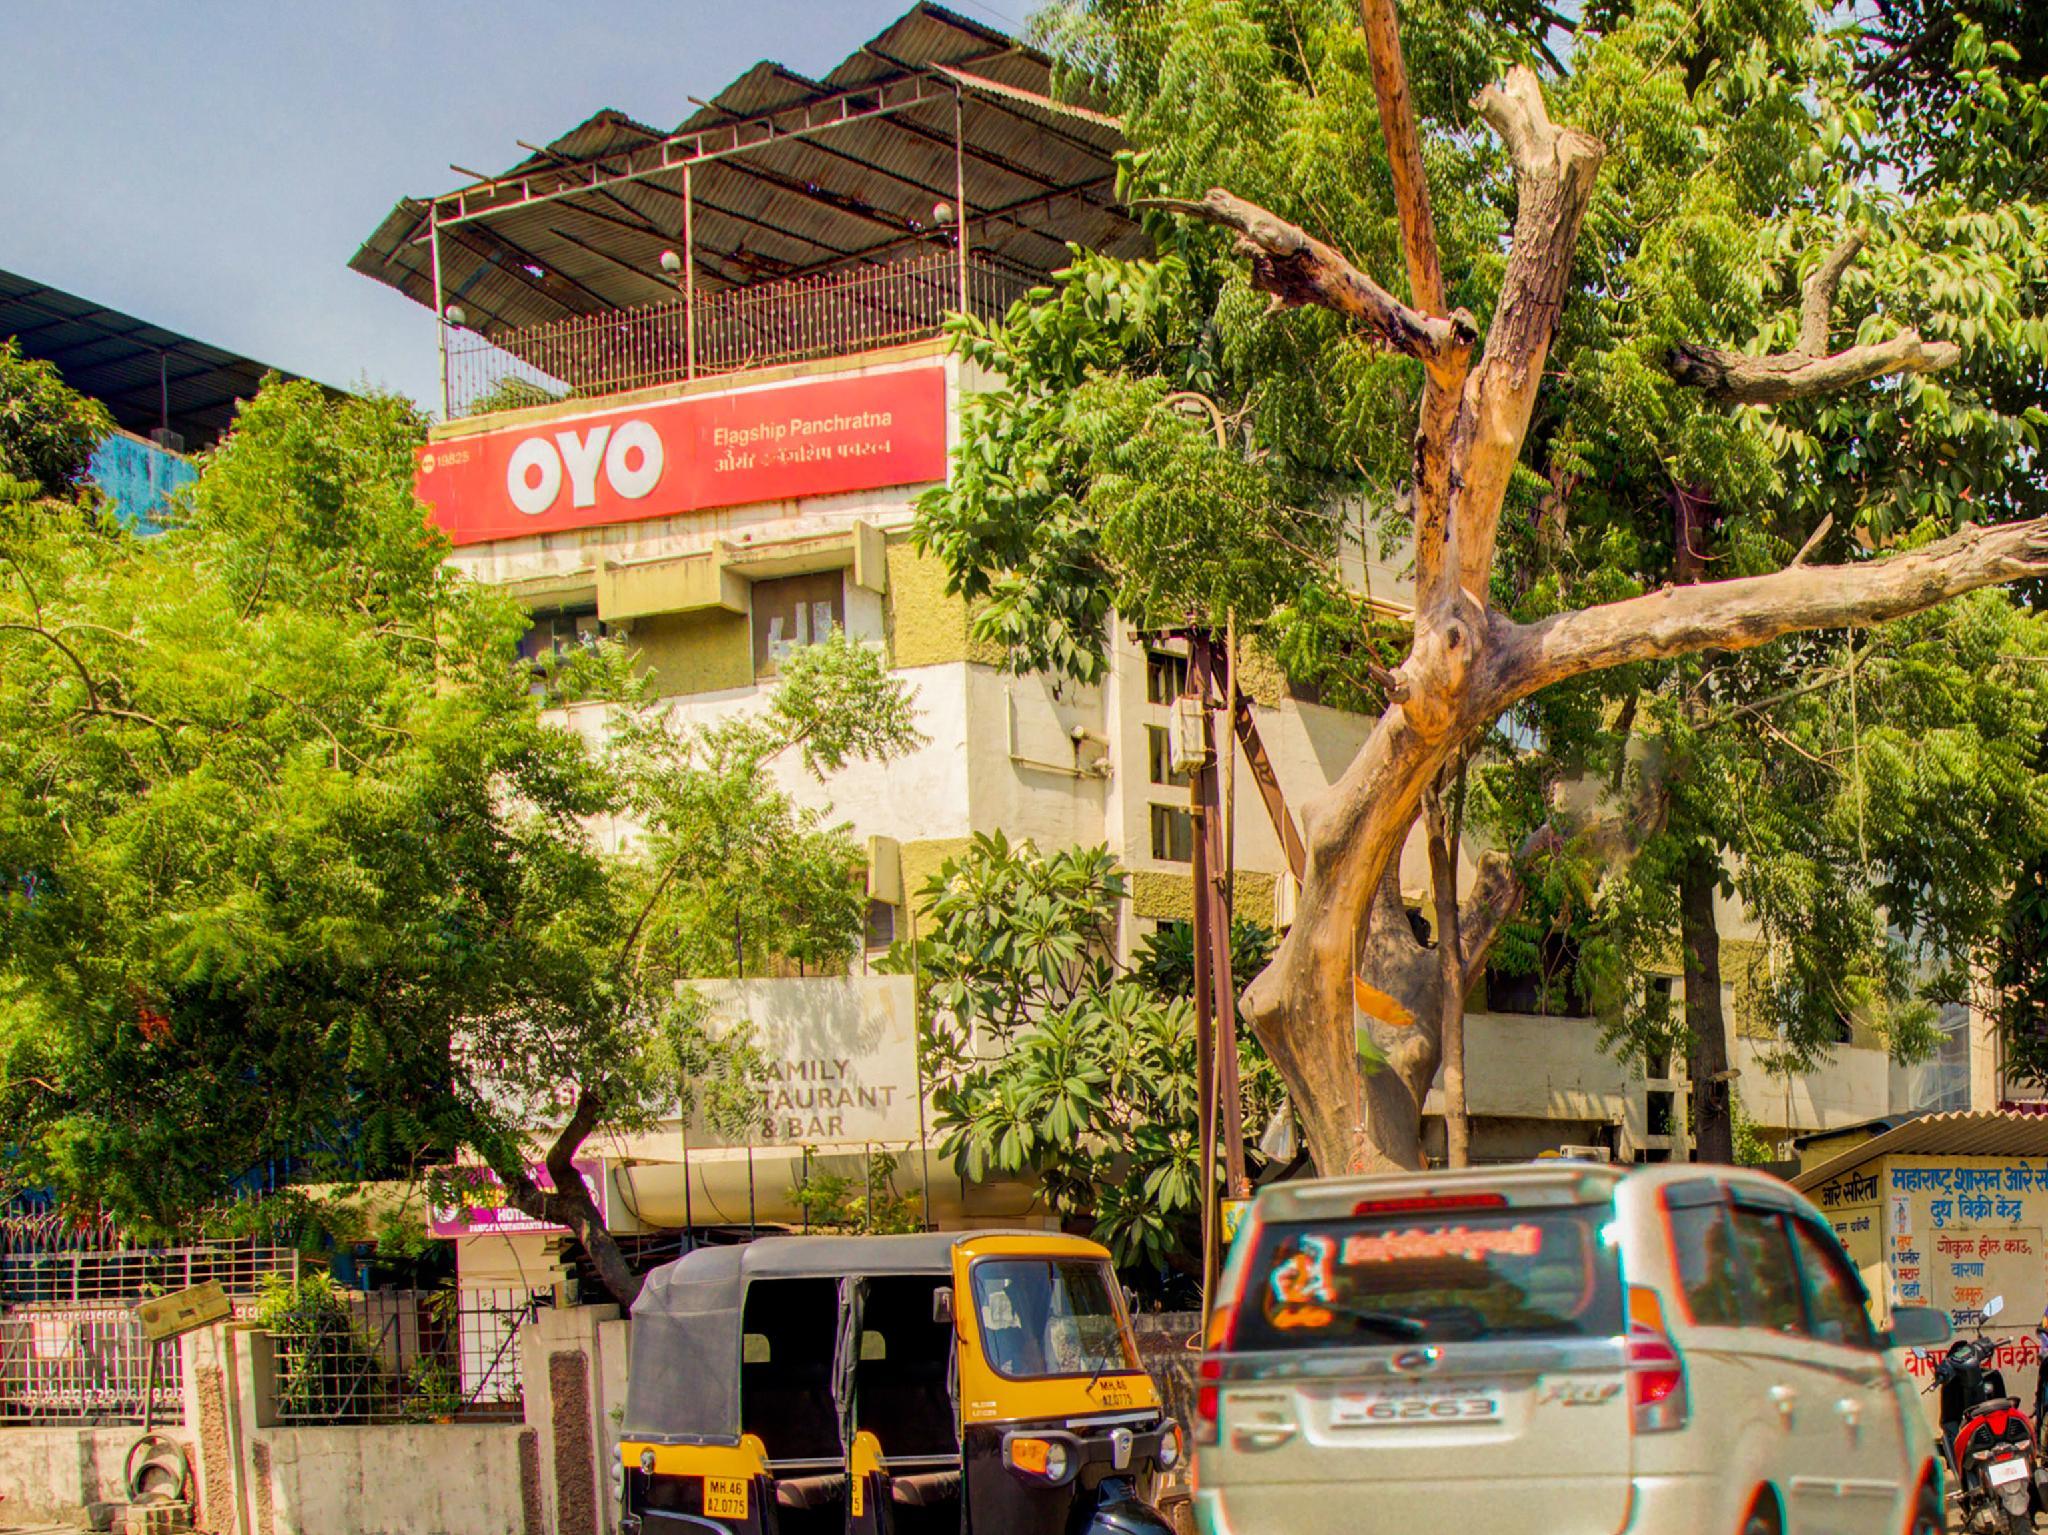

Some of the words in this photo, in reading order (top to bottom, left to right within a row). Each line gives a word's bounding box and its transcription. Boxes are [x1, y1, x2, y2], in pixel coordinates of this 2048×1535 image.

[714, 423, 786, 447] Flagship
[790, 411, 892, 436] Panchratna
[507, 419, 664, 515] OYO
[764, 1059, 850, 1082] AMILY
[758, 1086, 897, 1110] TAURANT
[788, 1116, 845, 1138] BAR
[1843, 1171, 1879, 1203] सरिता
[1891, 1168, 1953, 1195] महाराष्ट्र
[1954, 1167, 2002, 1193] शासन
[2003, 1161, 2033, 1193] आरे
[1958, 1194, 1993, 1222] विक्री
[1995, 1194, 2023, 1223] केंद्र
[1937, 1235, 1974, 1259] गोकुळ
[1951, 1262, 1985, 1279] वारणा
[710, 1481, 742, 1496] MH.46
[708, 1498, 745, 1514] AZ.0775
